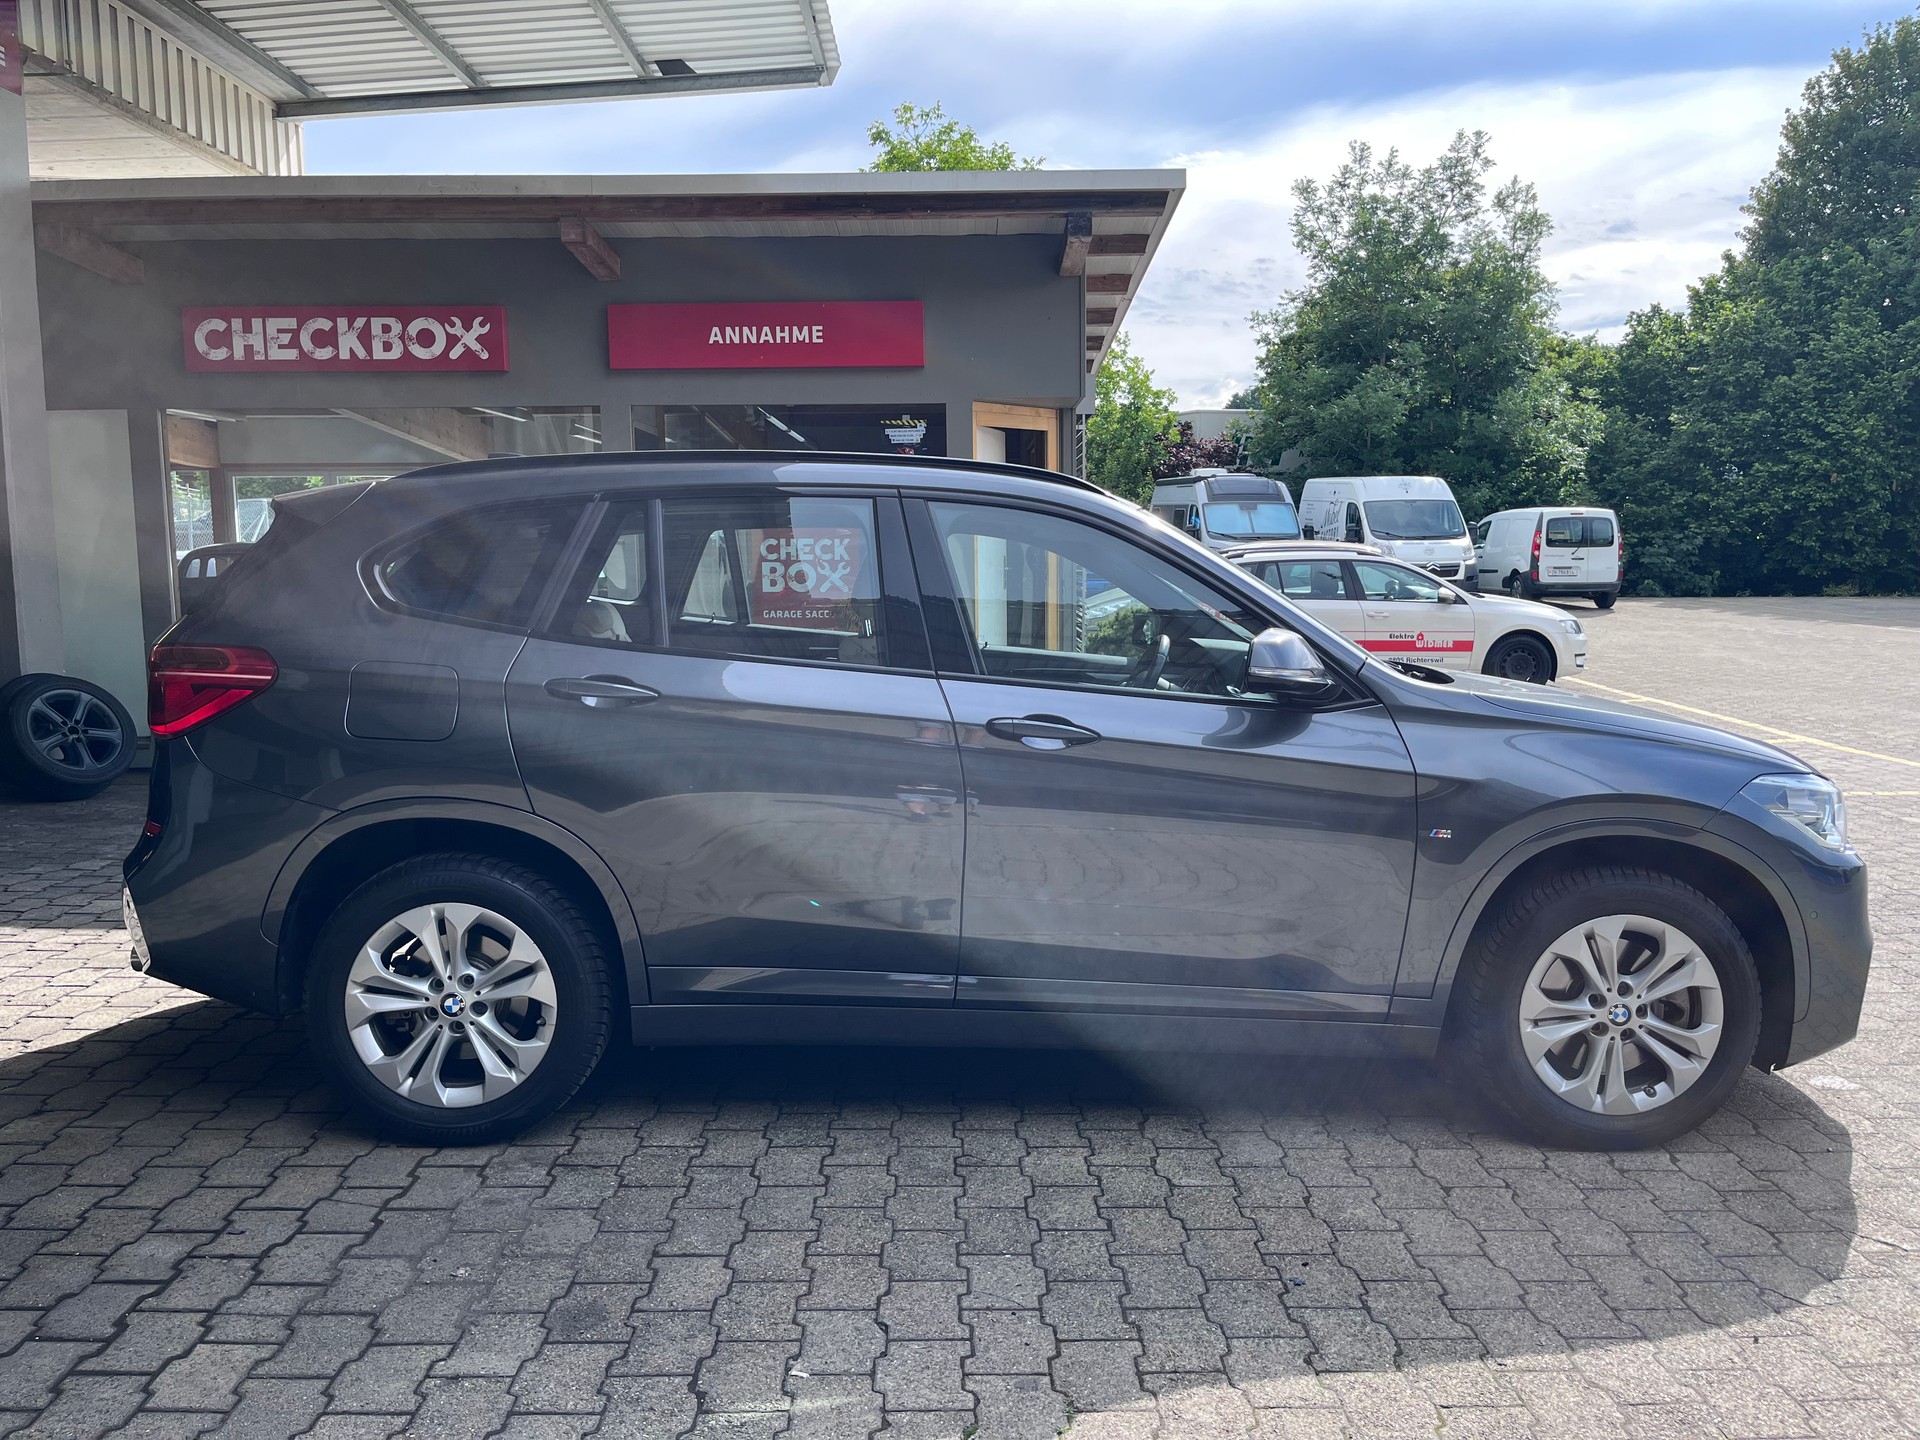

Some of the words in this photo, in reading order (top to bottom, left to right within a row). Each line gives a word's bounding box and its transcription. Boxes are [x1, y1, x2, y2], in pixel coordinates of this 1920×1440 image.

[194, 316, 491, 361] CHECKBOX
[708, 325, 824, 344] ANNAHME
[760, 538, 851, 561] CHECK
[761, 561, 851, 593] BOX
[763, 610, 803, 618] GARAGE
[1406, 656, 1444, 664] Richterswil
